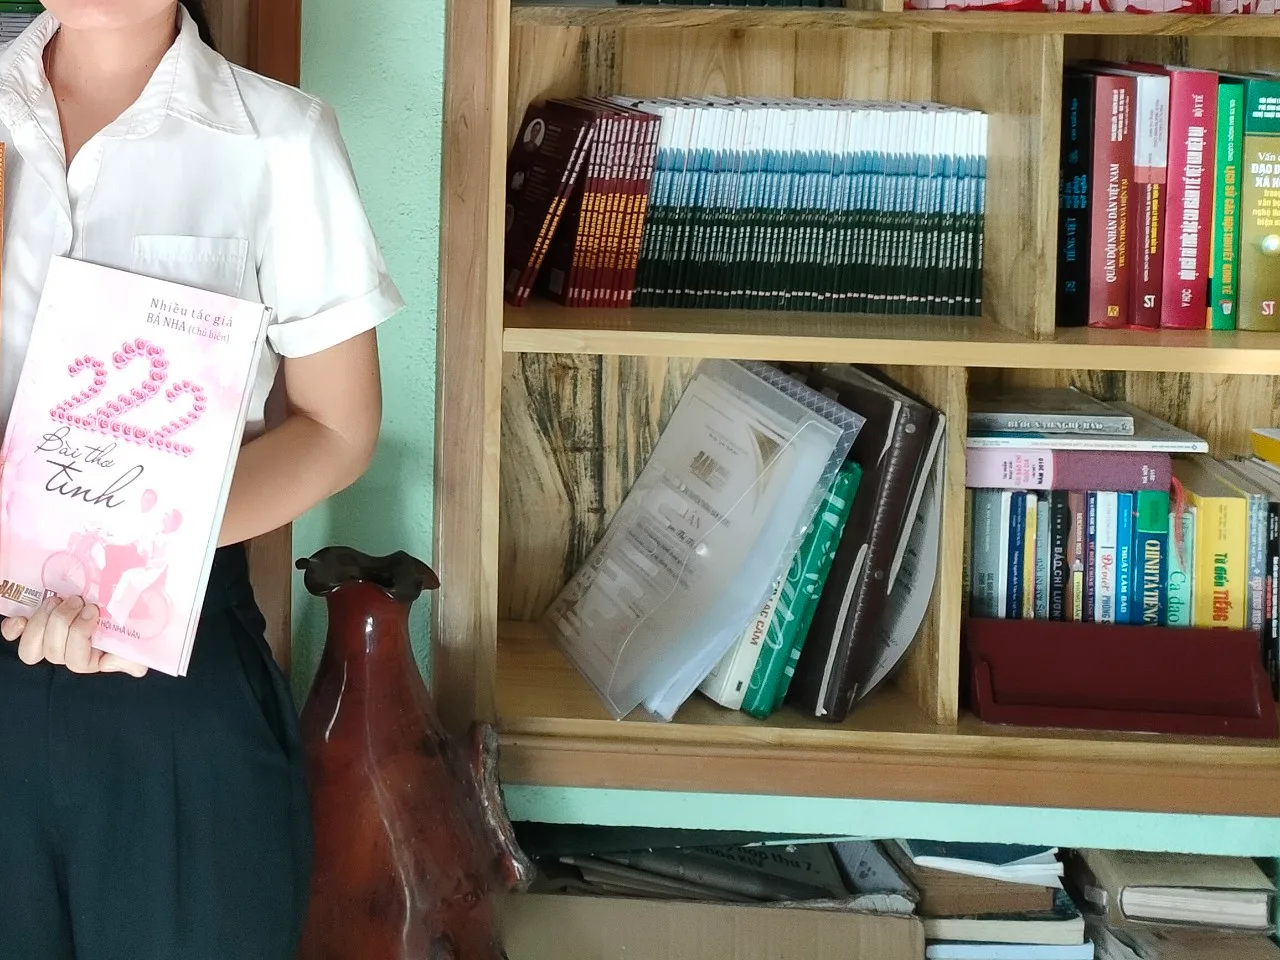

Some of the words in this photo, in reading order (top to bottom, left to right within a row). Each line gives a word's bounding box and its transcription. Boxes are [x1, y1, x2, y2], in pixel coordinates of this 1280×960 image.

[1110, 164, 1119, 182] NAM
[1106, 219, 1118, 242] NHÂN
[1105, 259, 1117, 282] QUÂN
[146, 312, 161, 326] BÁ
[163, 316, 186, 332] NHA
[150, 298, 188, 316] Nhiều
[191, 309, 211, 322] tác
[212, 315, 233, 327] giả
[49, 336, 208, 458] 222
[35, 426, 82, 460] Bài
[84, 442, 117, 470] thơ
[44, 458, 145, 510] tình
[1144, 540, 1163, 573] CHÍNH
[1214, 553, 1228, 564] Từ
[1169, 571, 1186, 591] Ca
[1169, 597, 1185, 623] dao
[1213, 590, 1232, 621] TIẾNG
